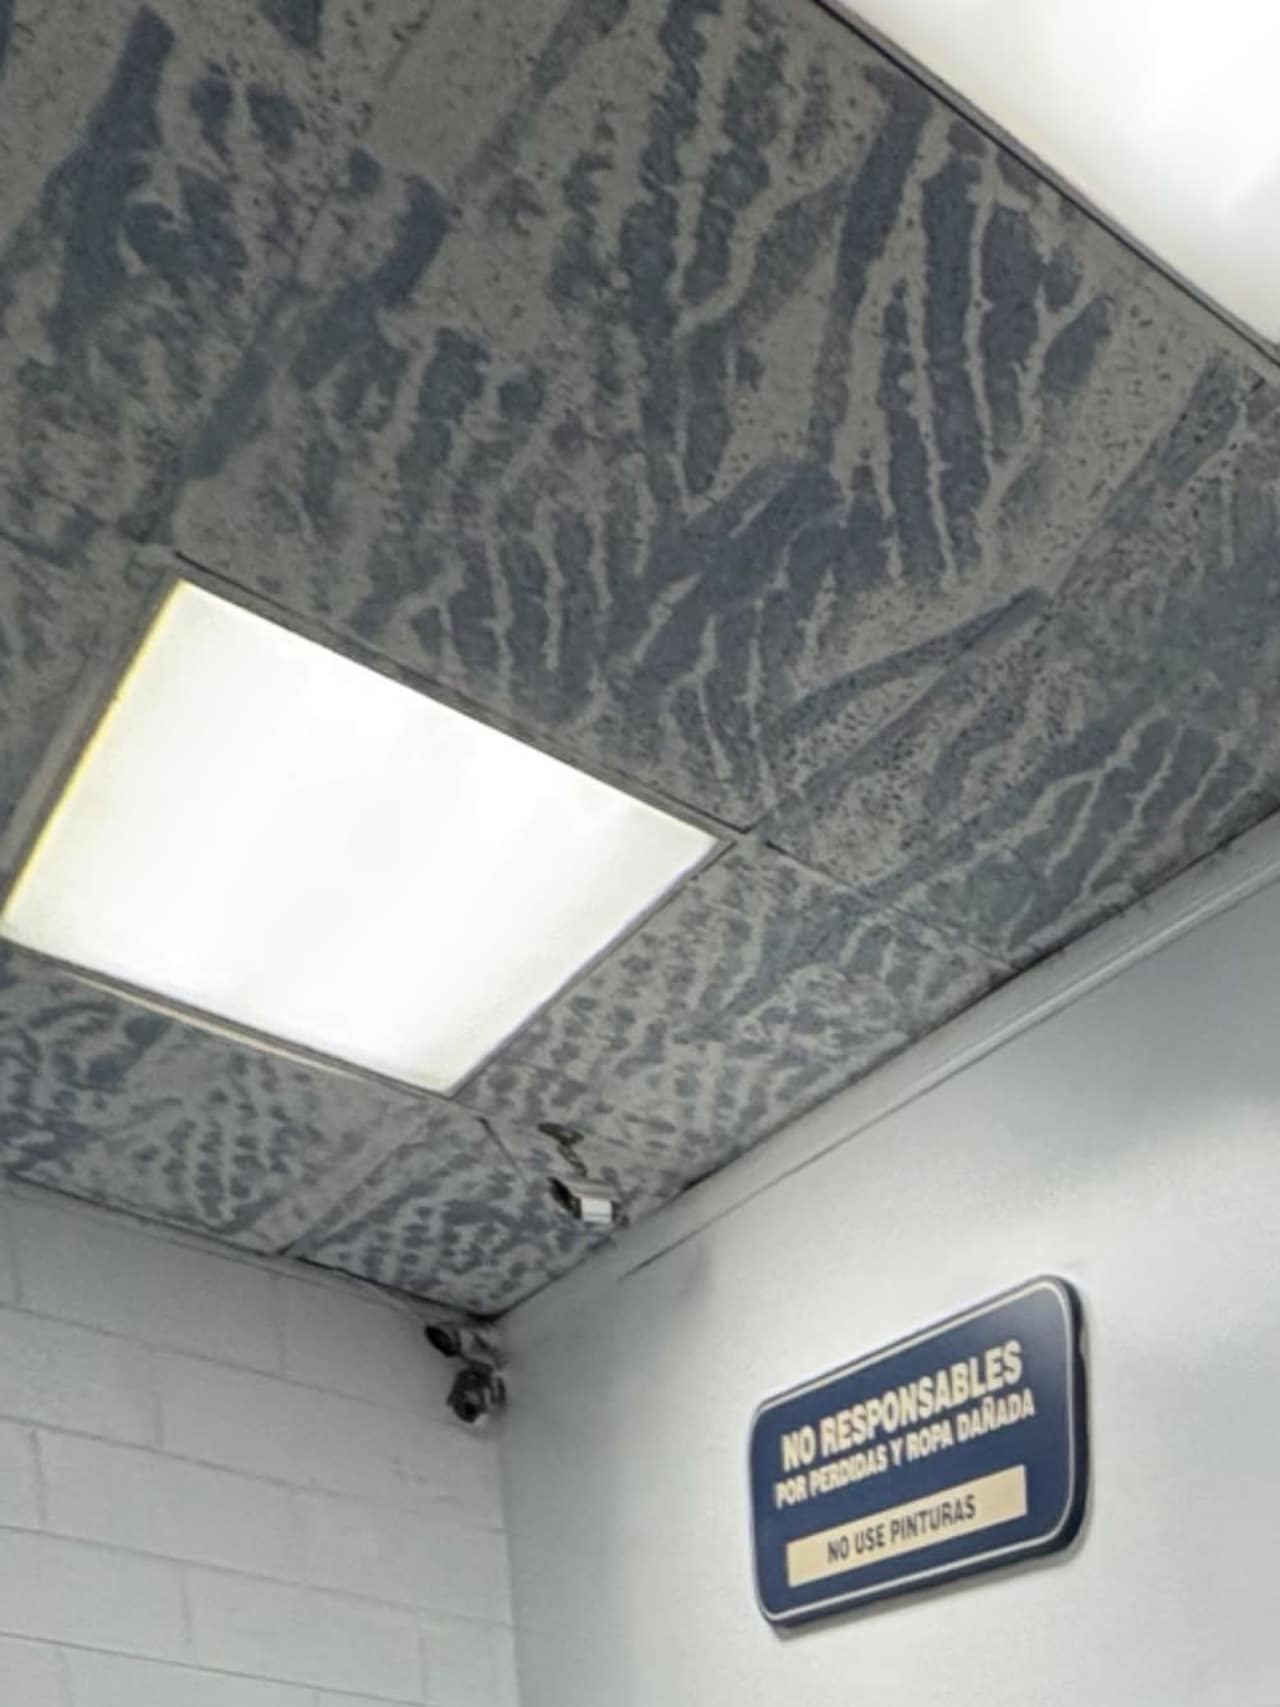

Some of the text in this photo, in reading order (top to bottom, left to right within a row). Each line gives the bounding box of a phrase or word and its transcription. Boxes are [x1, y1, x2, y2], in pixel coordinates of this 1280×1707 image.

[775, 1388, 1035, 1509] POR PERDIDAS Y ROPA DAÑADA
[781, 1340, 1022, 1471] NO RESPONSABLES
[827, 1494, 976, 1563] NO USE PINTURAS
